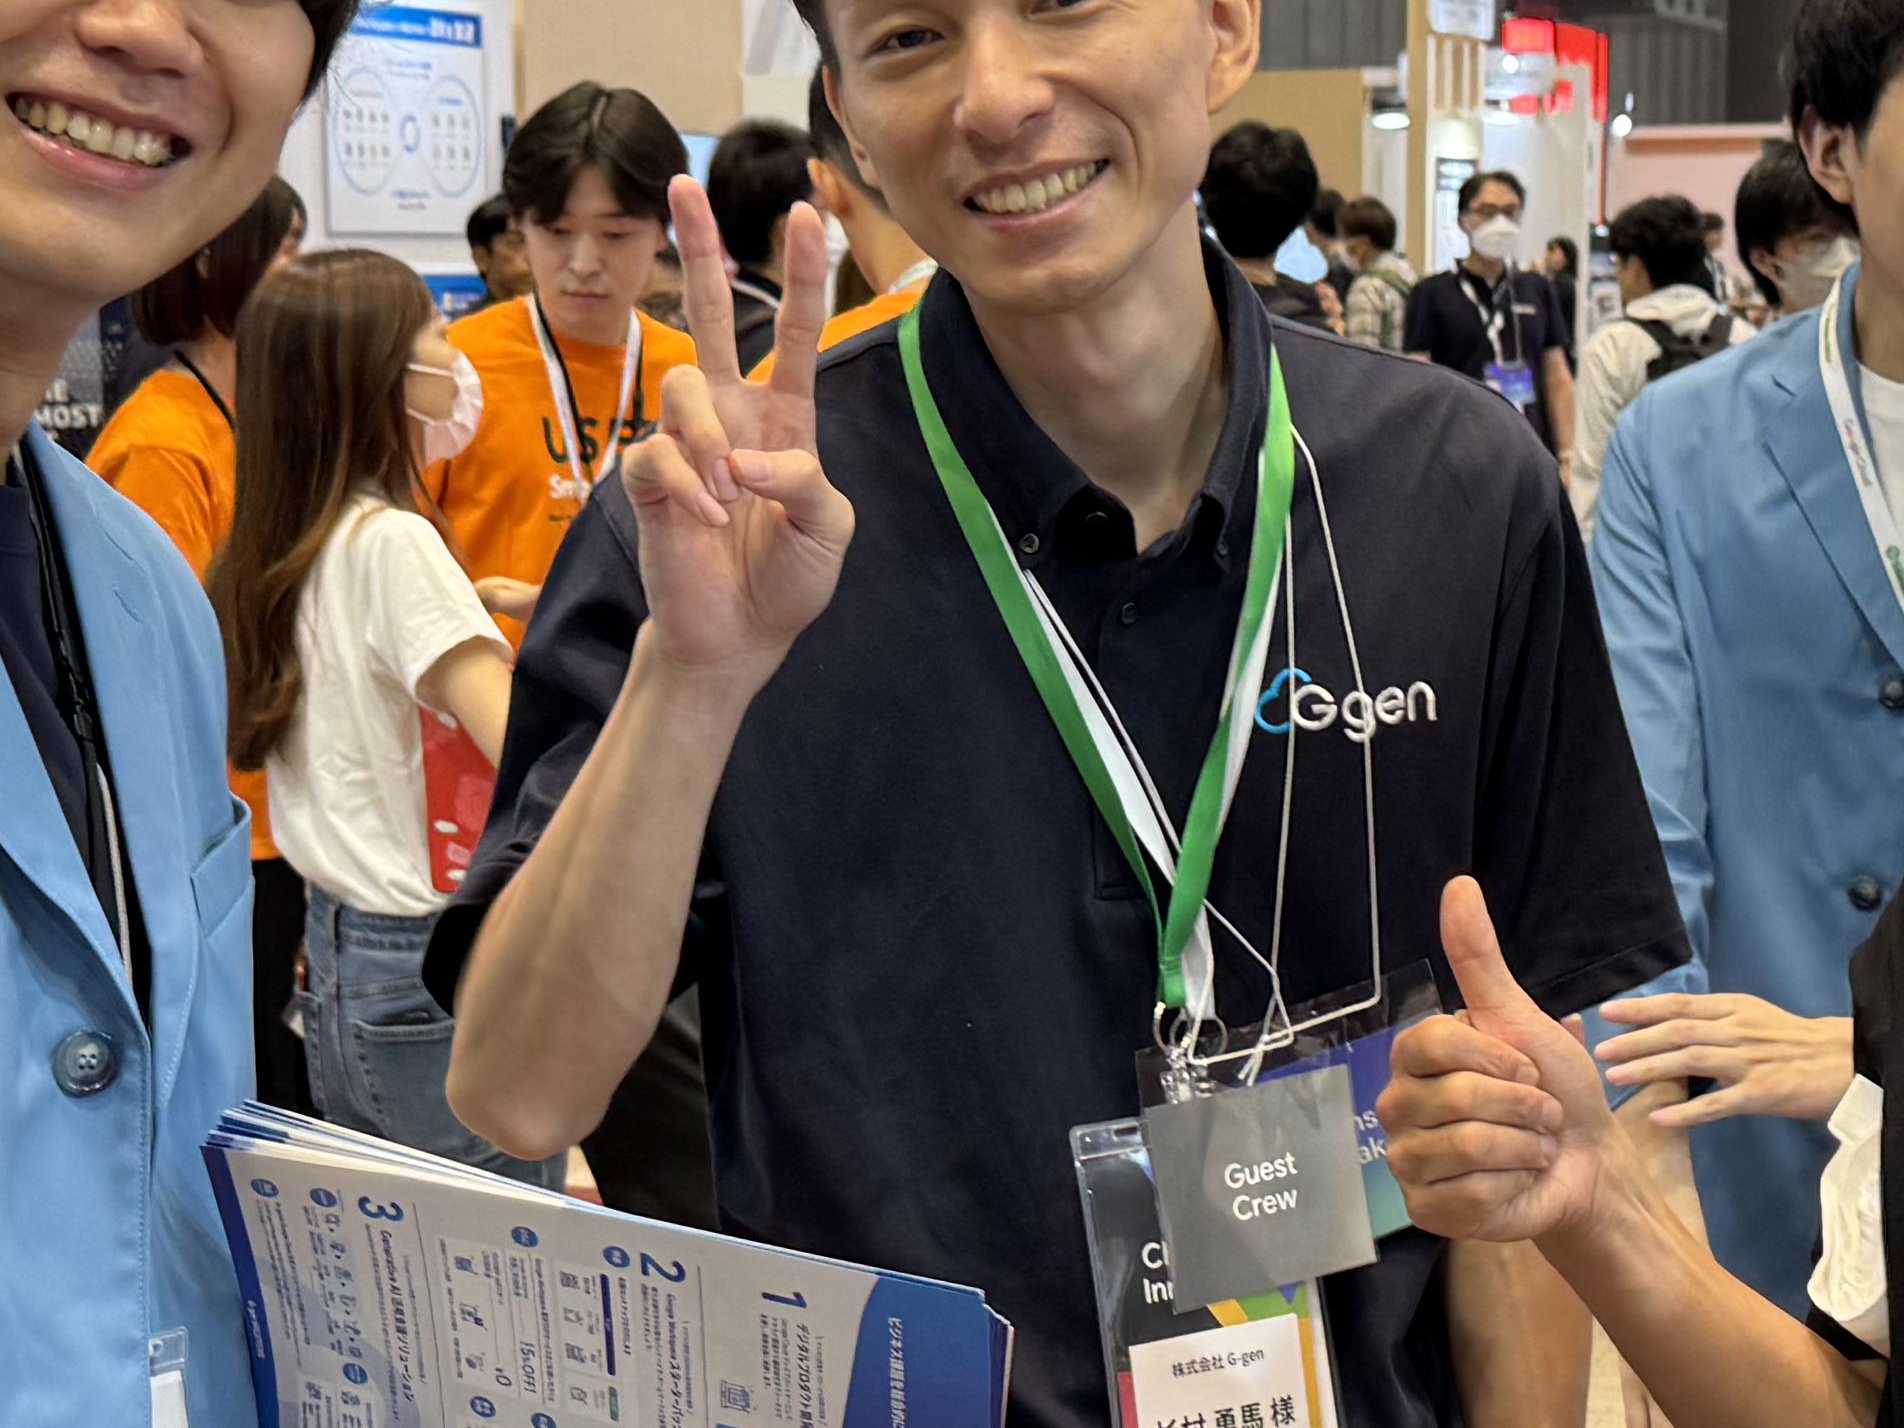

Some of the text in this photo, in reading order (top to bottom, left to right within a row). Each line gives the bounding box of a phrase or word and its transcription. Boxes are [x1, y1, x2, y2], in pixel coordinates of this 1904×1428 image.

[1223, 1151, 1298, 1190] Guest
[357, 1197, 404, 1220] 3
[1231, 1188, 1298, 1222] Crew
[639, 1252, 685, 1281] 2
[389, 1284, 401, 1295] AI
[762, 1291, 807, 1308] 1
[1171, 1346, 1265, 1380] 株式会社 G-gen
[1270, 1394, 1297, 1428] 様
